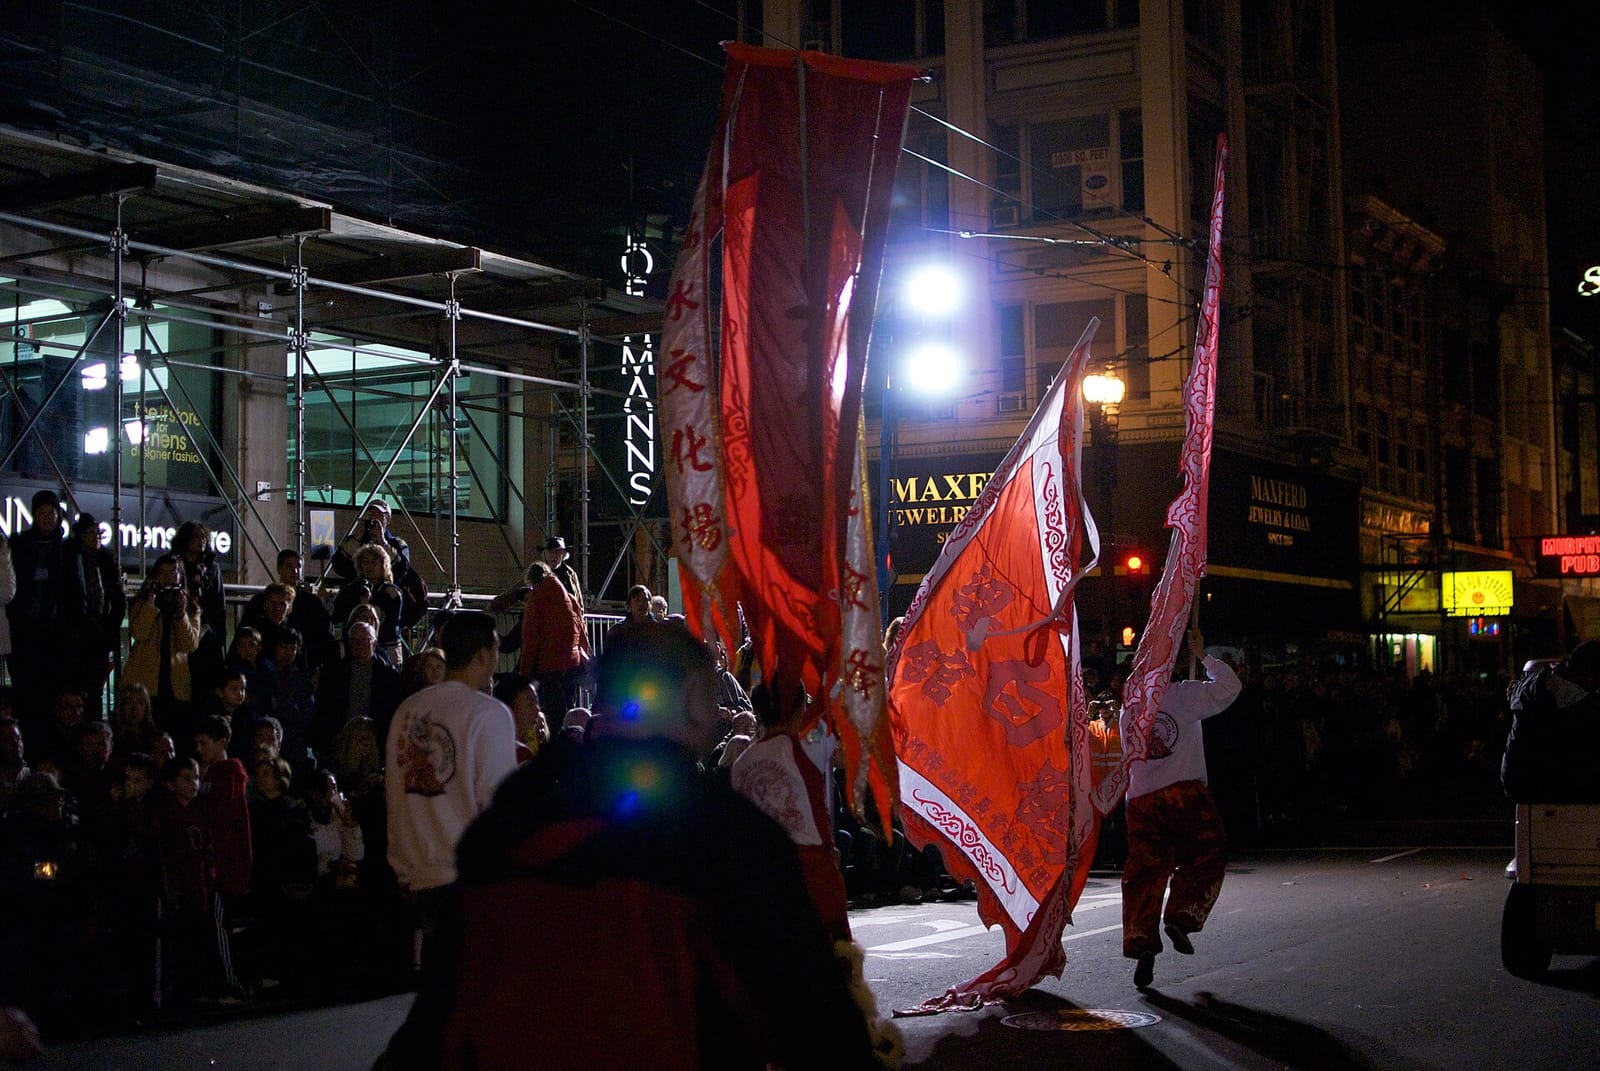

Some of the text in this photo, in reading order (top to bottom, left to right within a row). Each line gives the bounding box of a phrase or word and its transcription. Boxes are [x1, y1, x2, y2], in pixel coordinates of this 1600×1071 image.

[157, 421, 168, 433] for
[172, 450, 201, 464] fashio
[1561, 555, 1600, 574] PUB
